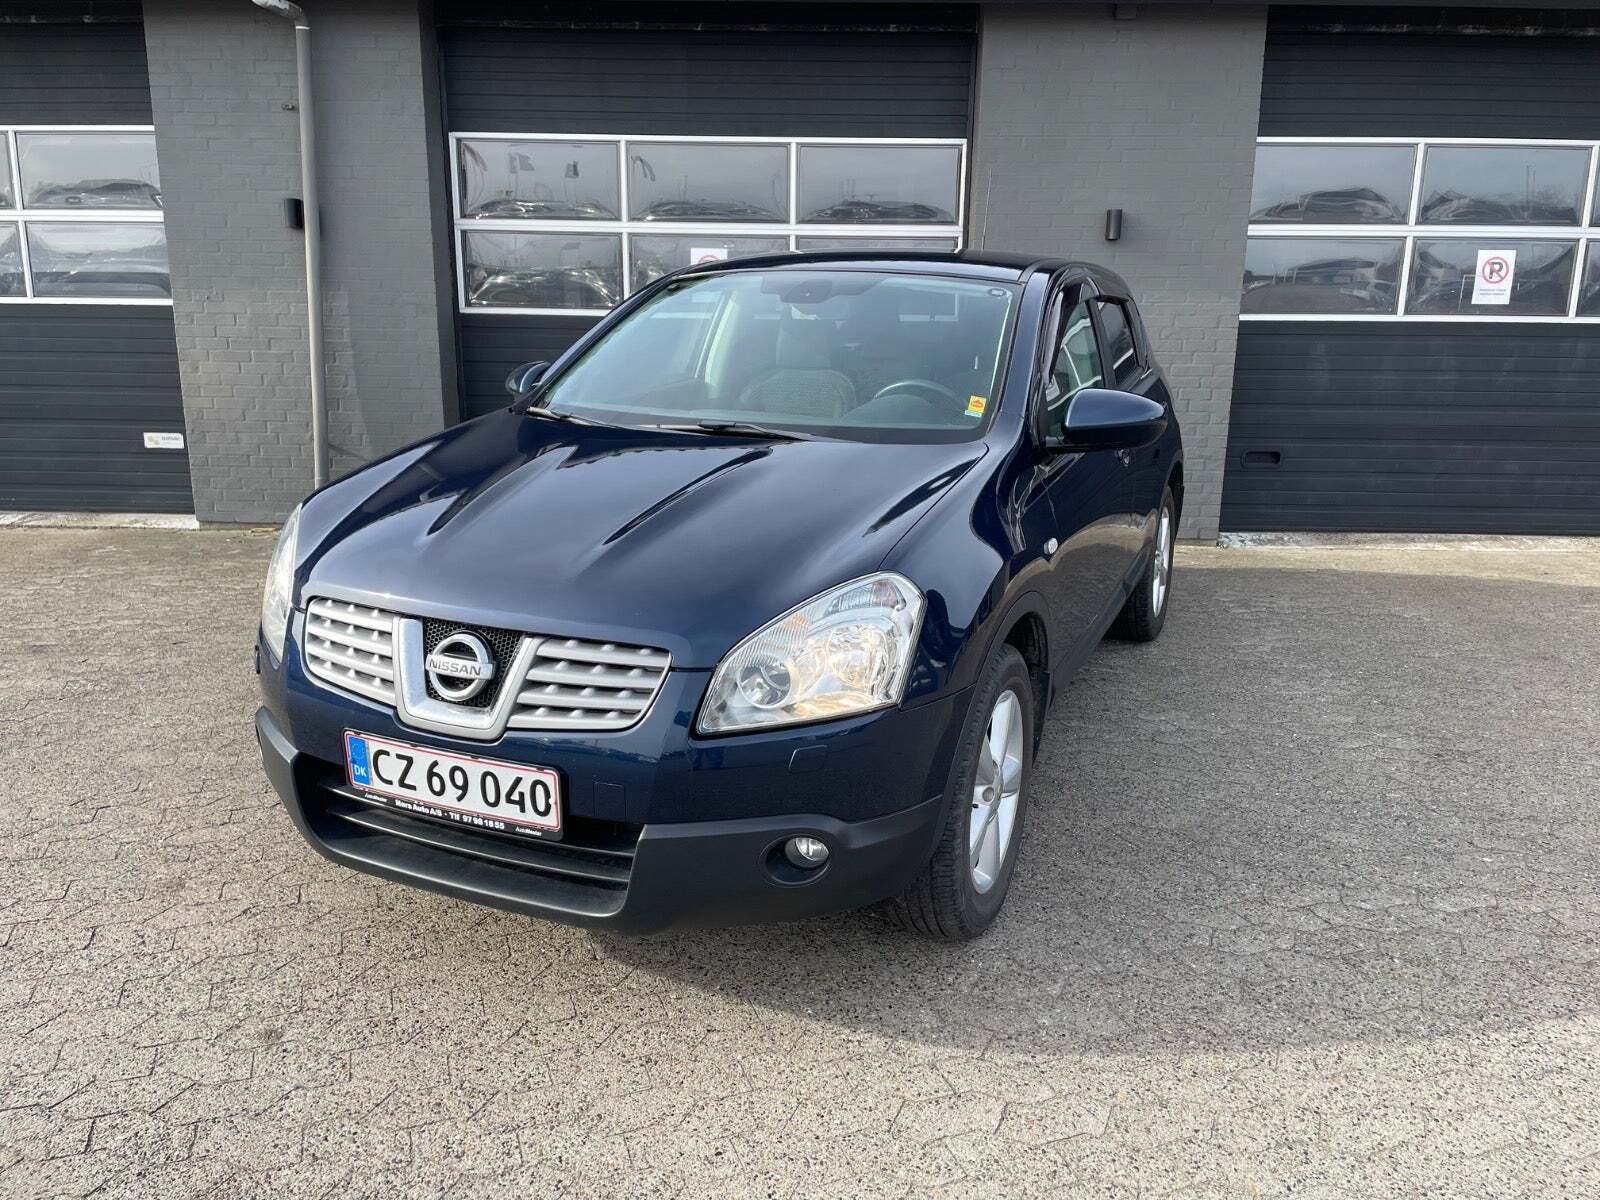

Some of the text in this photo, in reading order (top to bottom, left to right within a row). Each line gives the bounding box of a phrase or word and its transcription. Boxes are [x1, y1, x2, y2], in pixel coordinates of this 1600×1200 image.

[429, 658, 482, 676] NISSAN
[354, 764, 367, 777] DK
[372, 748, 552, 817] CZ 69 040
[412, 803, 430, 814] Auto
[462, 814, 473, 823] 97
[494, 821, 505, 830] 55
